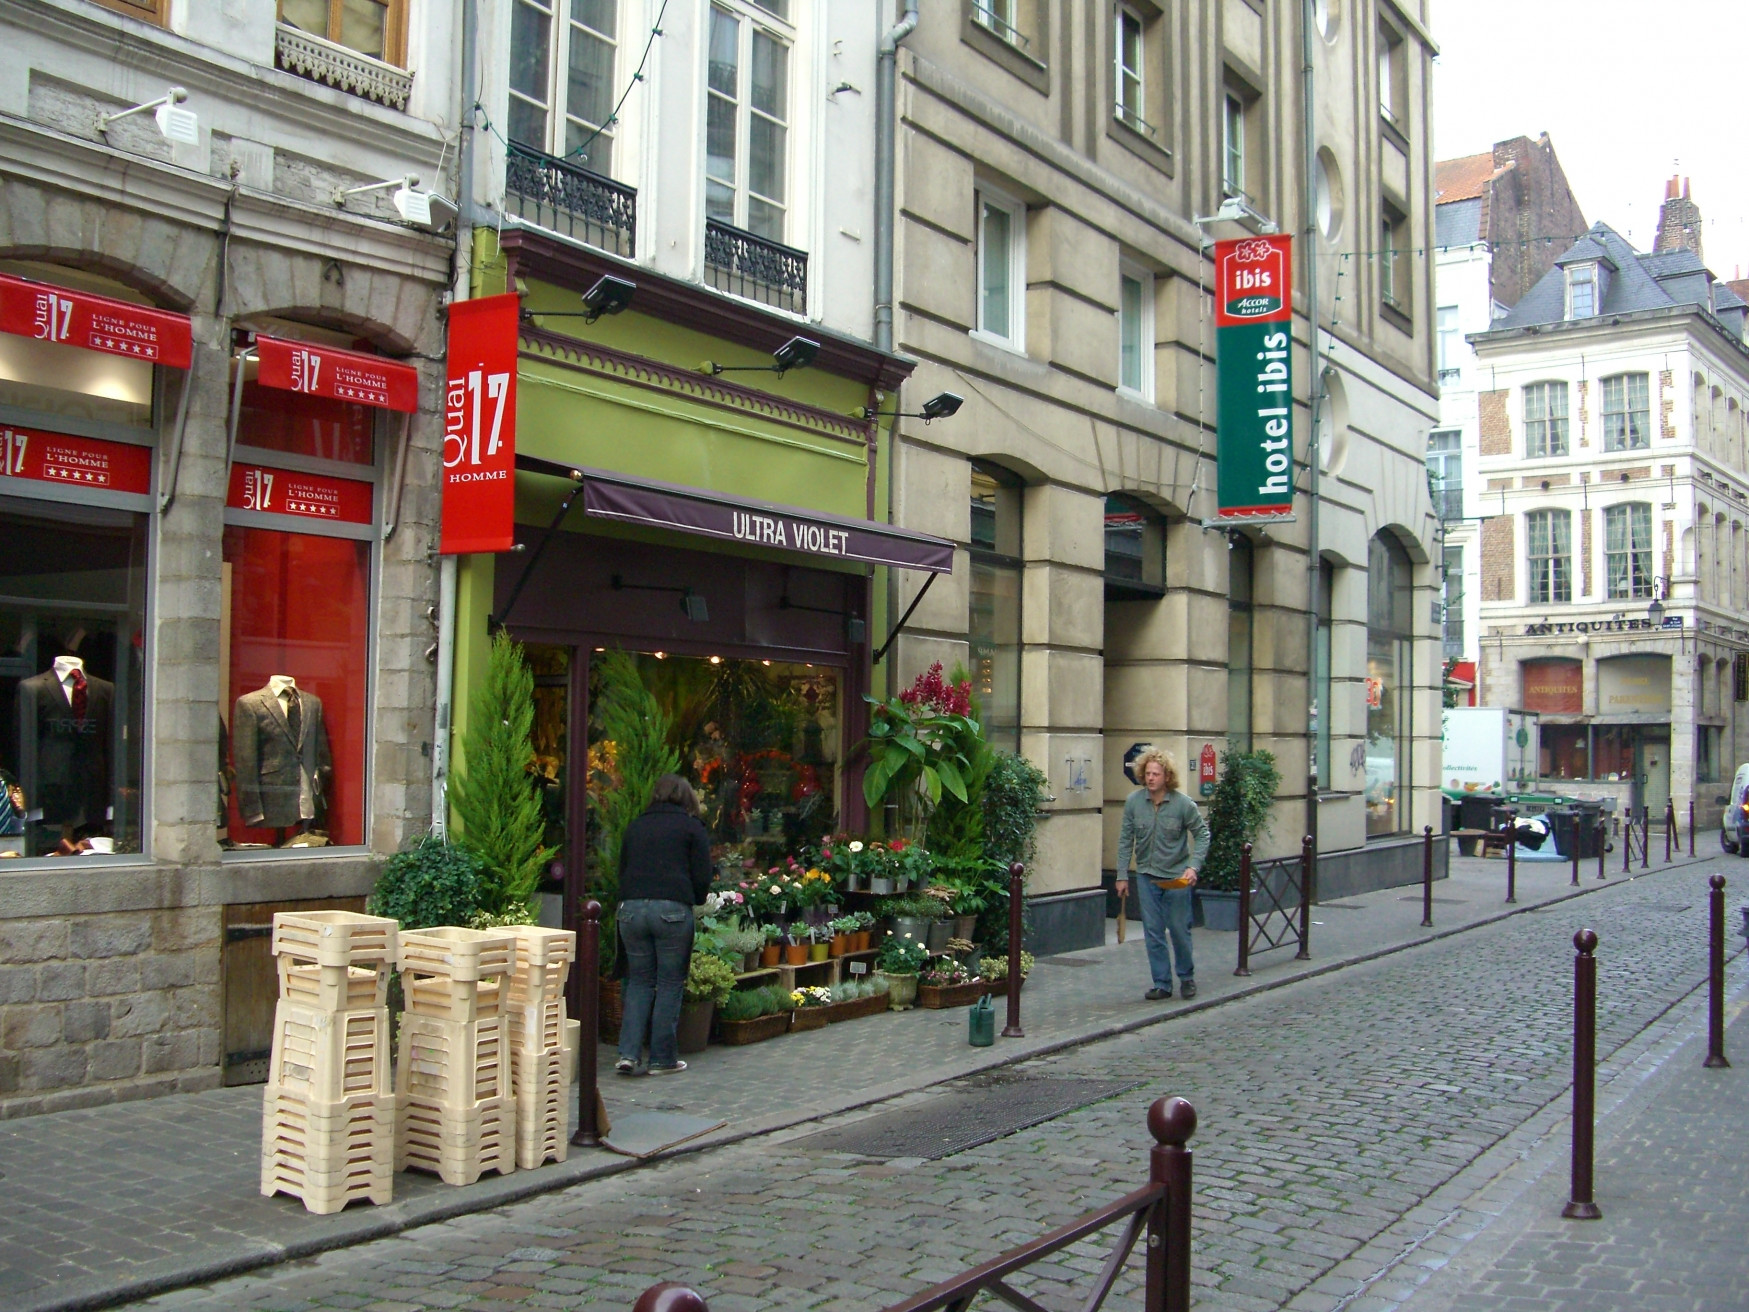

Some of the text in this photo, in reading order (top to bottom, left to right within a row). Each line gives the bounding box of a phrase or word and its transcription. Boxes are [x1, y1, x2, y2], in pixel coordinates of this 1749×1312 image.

[1235, 267, 1272, 290] ibis
[34, 294, 49, 339] Quai
[1241, 306, 1267, 315] hotels
[92, 314, 157, 332] LIGNE POUR
[92, 321, 157, 341] L'HOMME
[290, 351, 303, 391] Quai
[336, 366, 387, 382] LIGNE POUR
[336, 373, 387, 389] L'HOMME
[1256, 331, 1288, 495] hotel ibis
[443, 376, 468, 468] Quai
[46, 446, 108, 460] LIGNE POUR
[46, 453, 109, 469] L'HOMME
[449, 470, 507, 483] HOMME
[243, 471, 255, 509] Quai
[288, 483, 339, 495] LIGNE POUR
[288, 489, 339, 502] L'HOMME
[733, 511, 849, 556] ULTRA VIOLET
[1203, 763, 1214, 776] ibis
